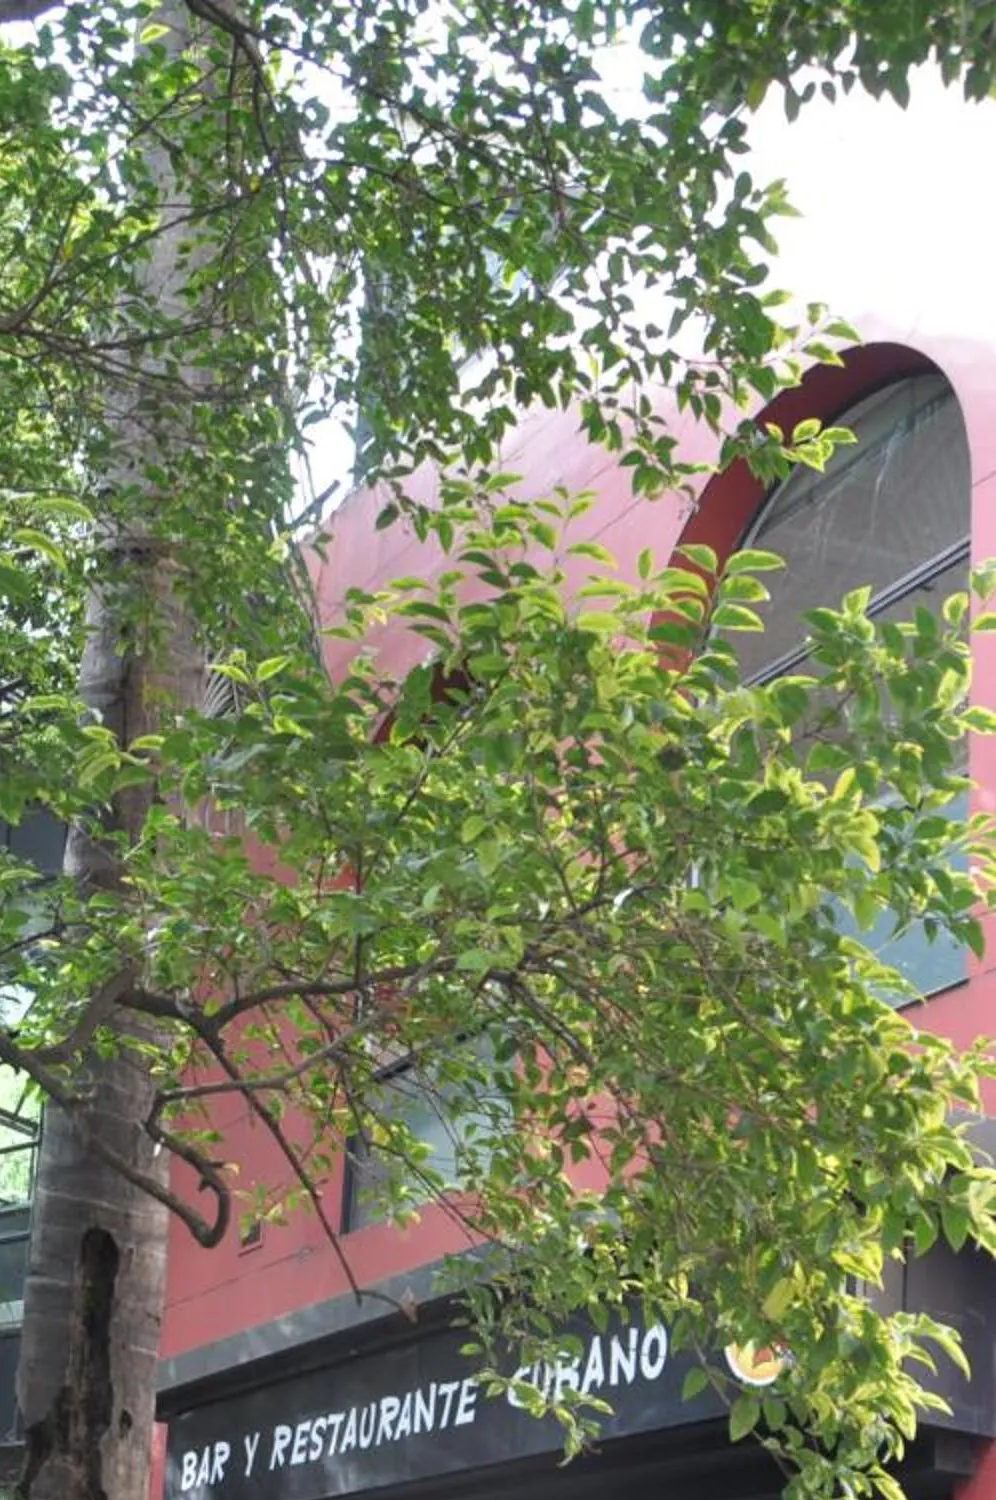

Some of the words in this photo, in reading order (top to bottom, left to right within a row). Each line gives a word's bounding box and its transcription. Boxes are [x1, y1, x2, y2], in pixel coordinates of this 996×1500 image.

[180, 1440, 231, 1491] BAR
[242, 1431, 261, 1477] Y
[268, 1377, 479, 1471] RESTAURANTE
